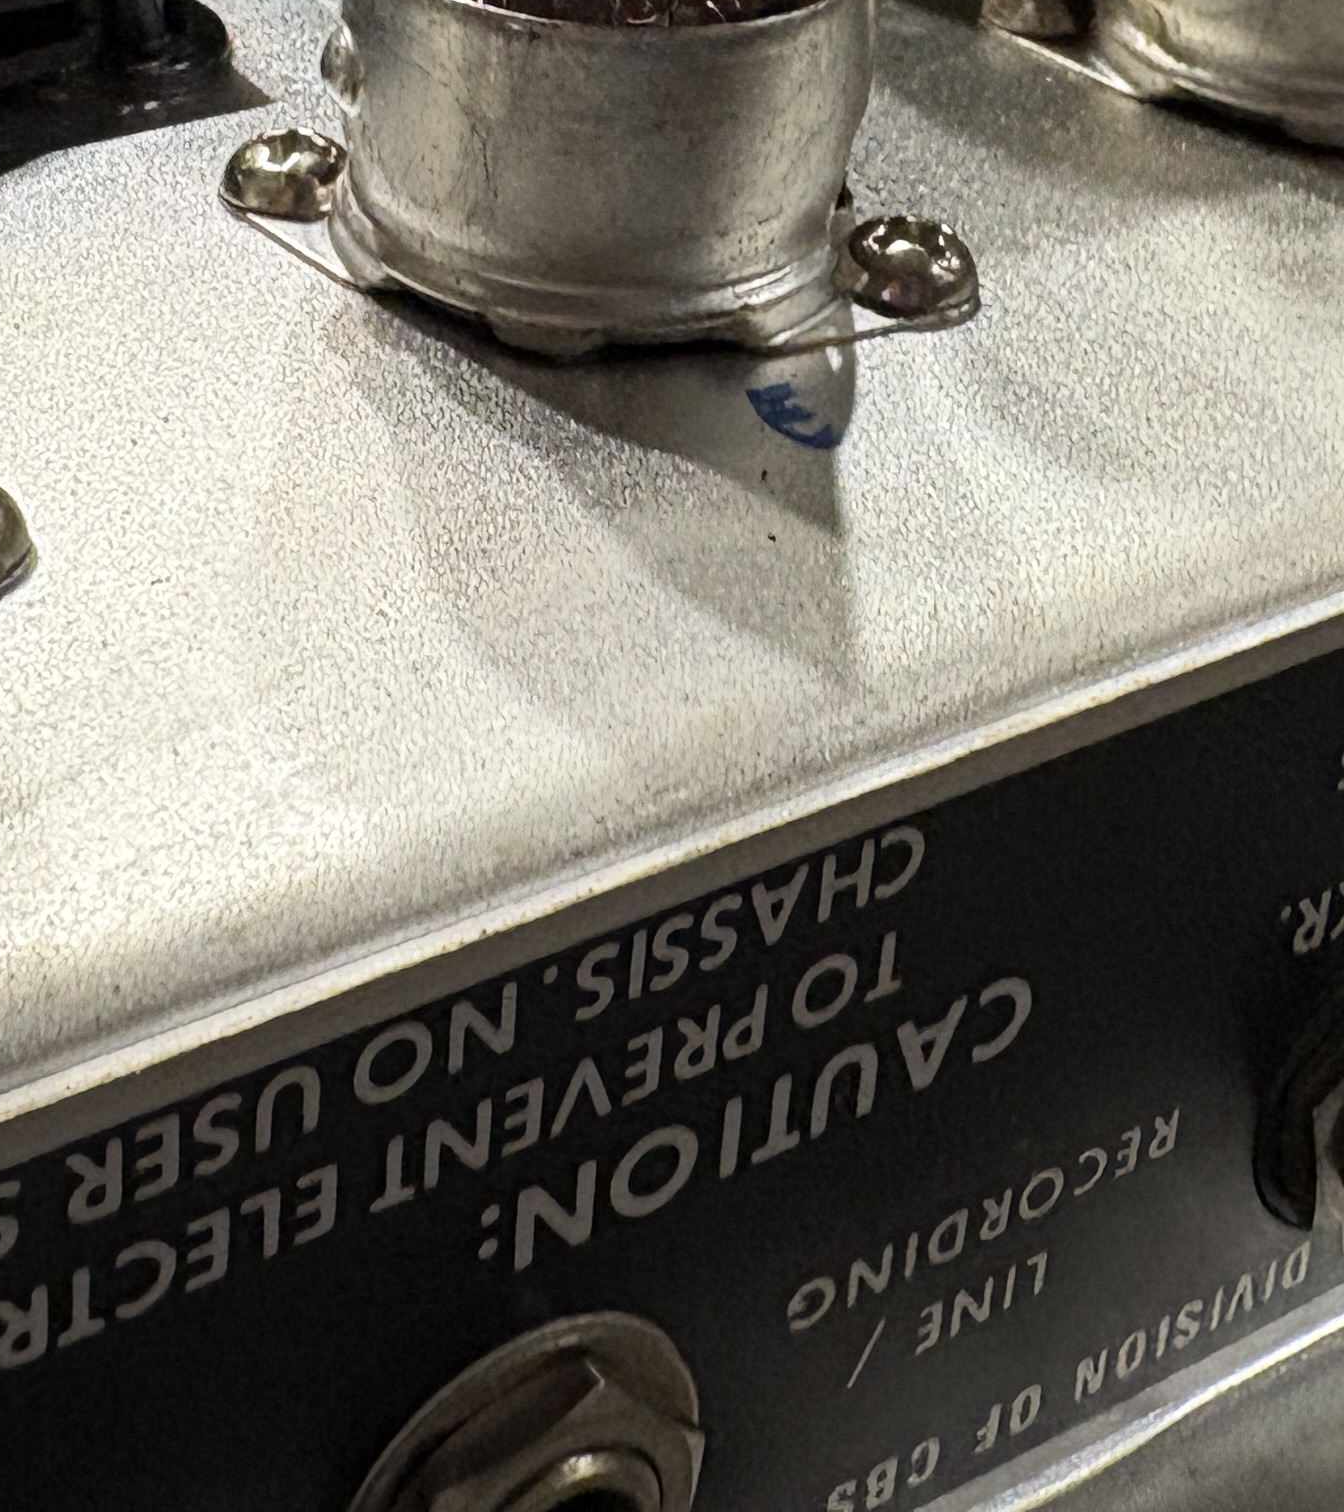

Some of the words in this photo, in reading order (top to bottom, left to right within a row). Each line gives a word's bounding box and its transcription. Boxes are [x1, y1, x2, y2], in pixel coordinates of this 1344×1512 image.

[543, 825, 927, 1022] CHASSIS.
[790, 930, 903, 1030] TO
[353, 981, 518, 1106] NO
[369, 983, 769, 1214] PREVENT
[477, 975, 1033, 1273] CAUTION:
[65, 1065, 322, 1226] USER
[786, 1107, 1181, 1332] RECORDING
[914, 1250, 1049, 1357] LINE
[1072, 1228, 1310, 1403] DIVISION
[973, 1383, 1043, 1455] OF
